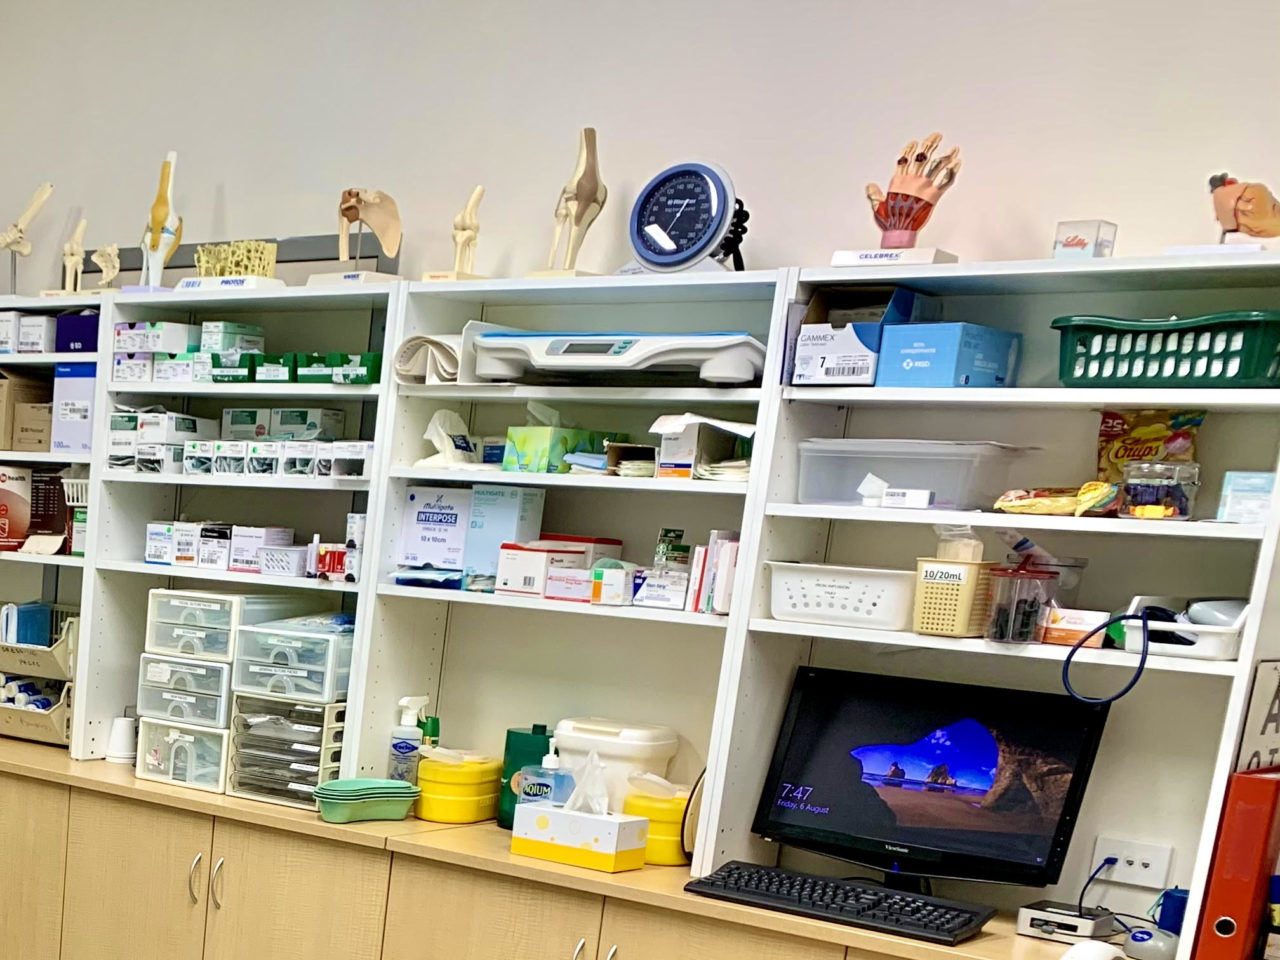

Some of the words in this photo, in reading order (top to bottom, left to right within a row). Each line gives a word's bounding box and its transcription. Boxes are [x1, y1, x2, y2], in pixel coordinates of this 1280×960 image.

[858, 251, 903, 260] CELEBREX
[220, 278, 246, 287] PROTOS
[801, 334, 835, 342] GAMMEX
[820, 356, 826, 368] 7
[418, 512, 457, 523] INTERPOSE
[923, 569, 963, 581] 10/20mL
[523, 783, 552, 796] AQIUM
[782, 783, 814, 801] 7:47
[776, 799, 799, 810] Friday,
[806, 804, 830, 815] August
